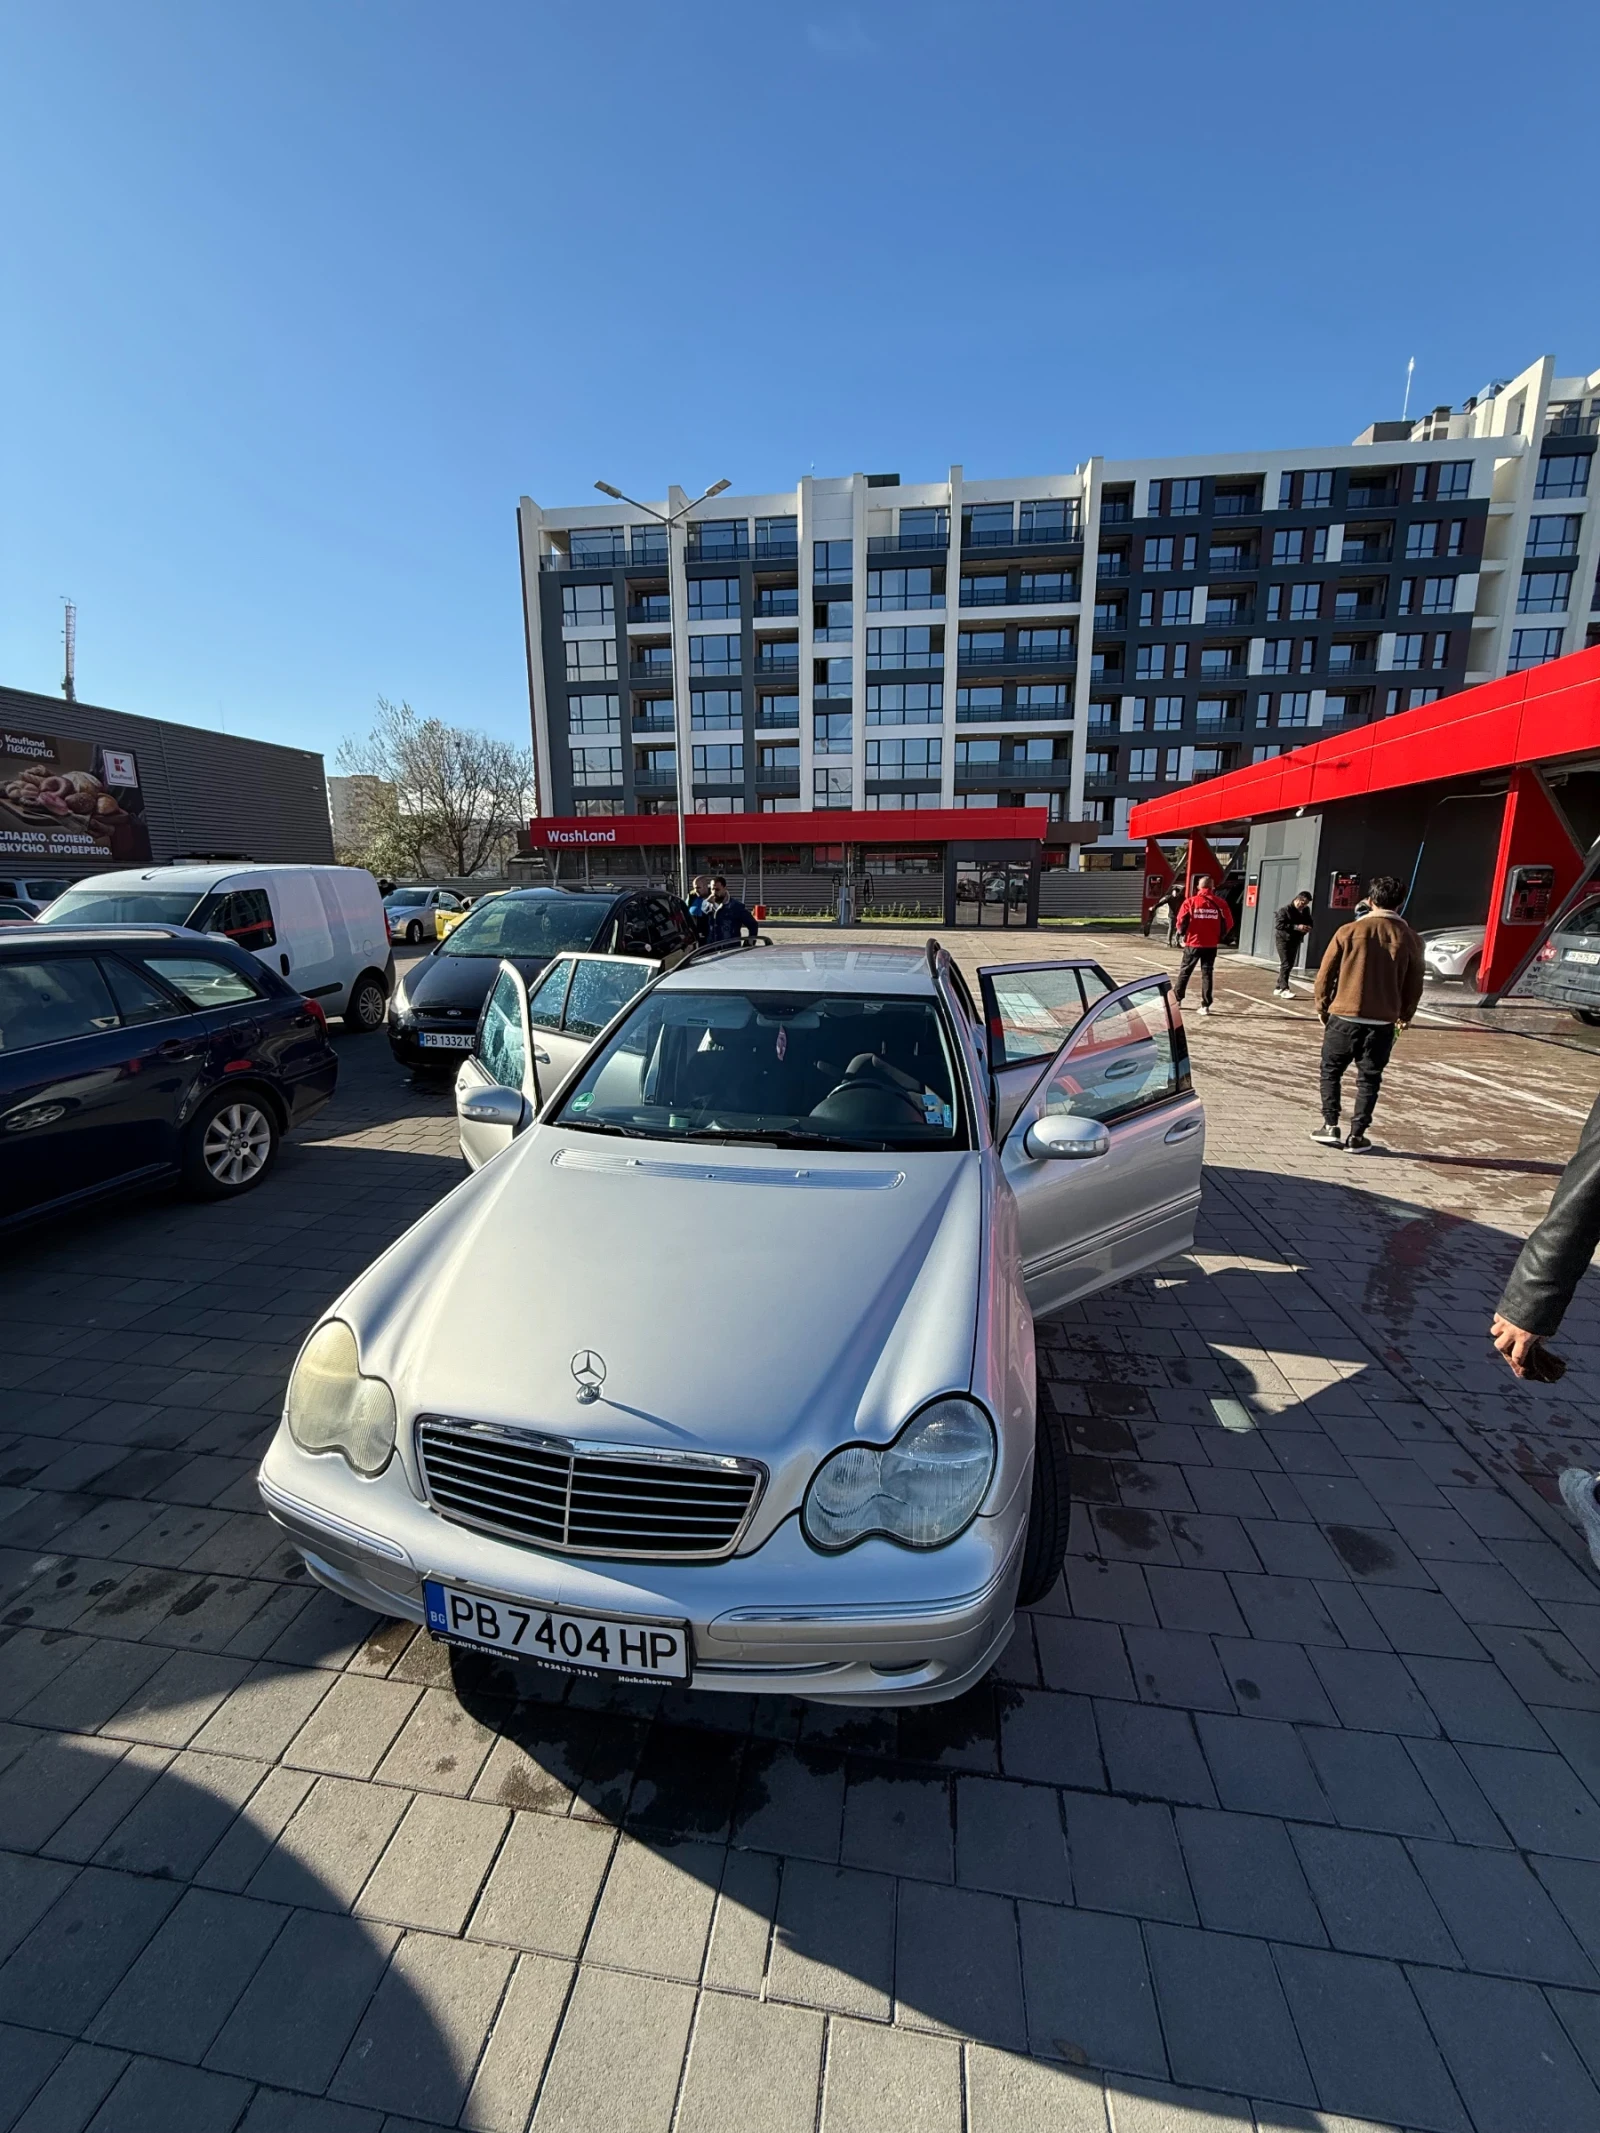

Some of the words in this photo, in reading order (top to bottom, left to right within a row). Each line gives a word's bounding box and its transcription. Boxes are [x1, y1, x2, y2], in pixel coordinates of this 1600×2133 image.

[5, 734, 46, 748] Kaufland
[7, 744, 55, 758] пекарна
[51, 834, 96, 844] СОЛЕНО.
[547, 829, 616, 842] WashLand
[0, 843, 47, 853] ВКУСНО.
[49, 845, 112, 855] ПРОВЕРЕНО.
[425, 1035, 438, 1046] PB
[440, 1036, 463, 1047] 1332
[430, 1611, 446, 1625] BG
[451, 1595, 500, 1639] PB
[508, 1610, 610, 1663] 7404
[620, 1628, 677, 1669] HP
